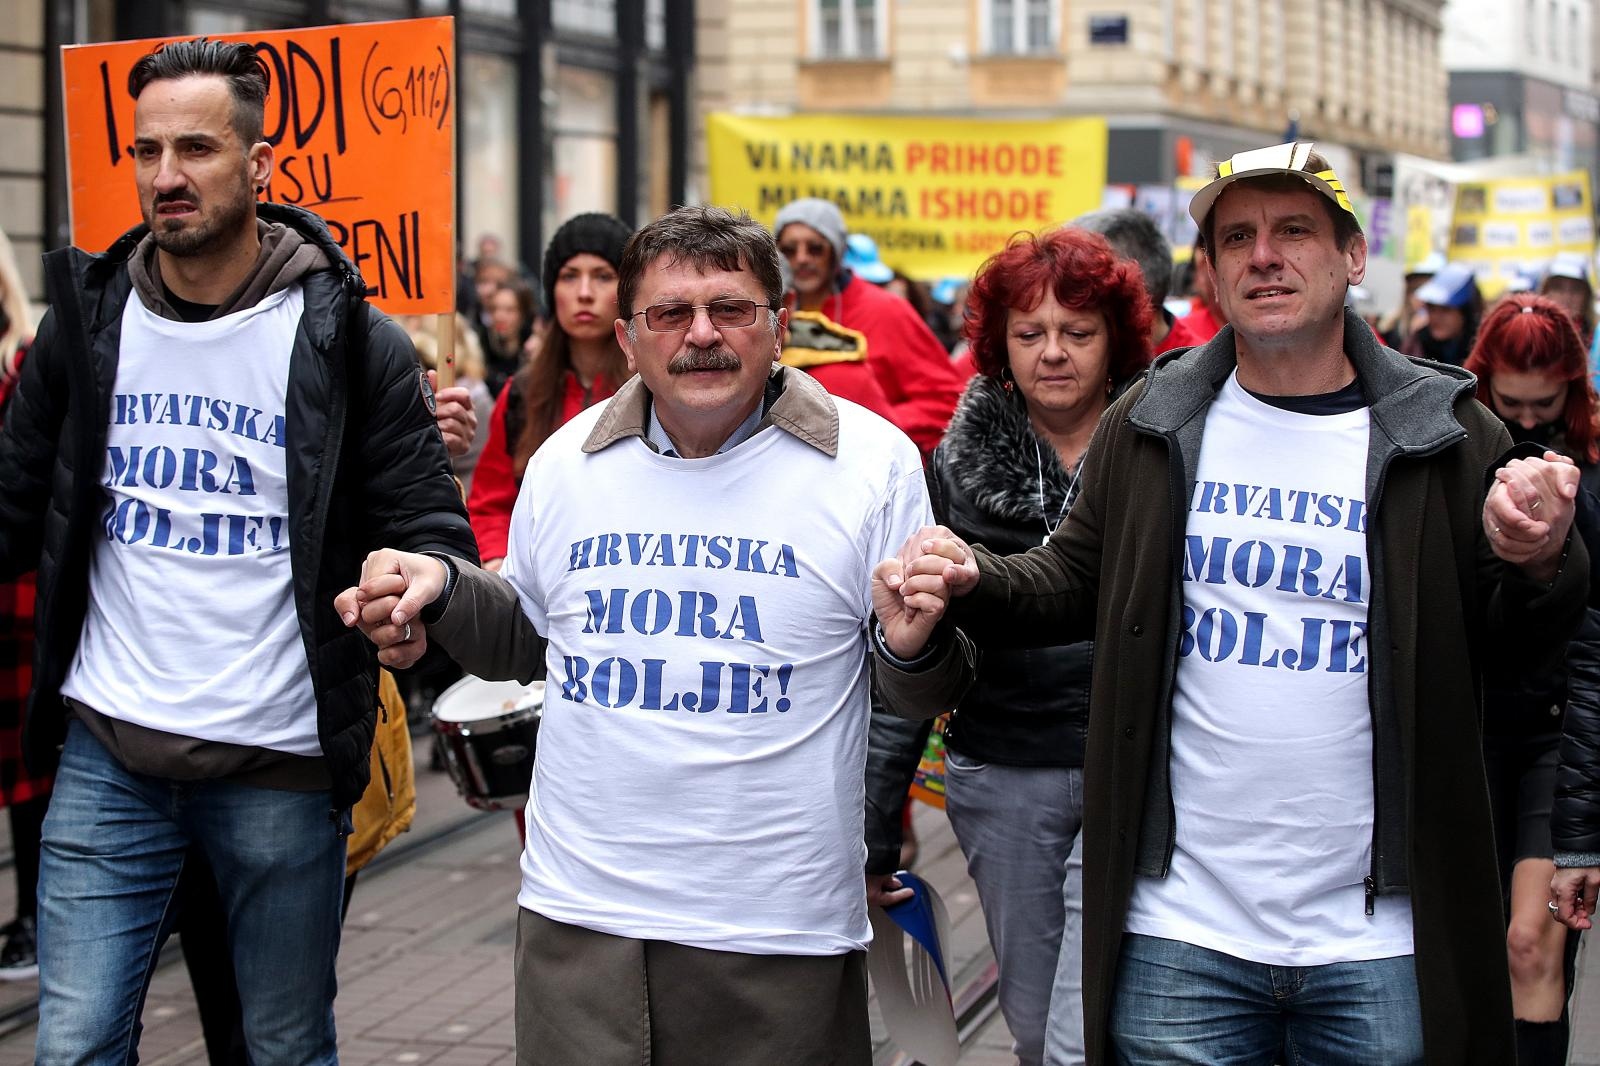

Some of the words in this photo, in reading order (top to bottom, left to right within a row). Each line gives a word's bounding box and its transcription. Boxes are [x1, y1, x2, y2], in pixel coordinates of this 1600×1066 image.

[362, 41, 450, 135] (6,11%)
[744, 141, 779, 171] VI
[792, 141, 895, 172] NAMA
[906, 140, 1064, 177] PRIHODE
[920, 186, 1053, 220] ISHODE
[108, 393, 286, 448] RVATSKA
[105, 445, 257, 496] MORA
[568, 533, 800, 578] HRVATSKA
[1183, 534, 1365, 604] MORA
[581, 588, 765, 643] MORA
[561, 655, 794, 714] BOLJE!
